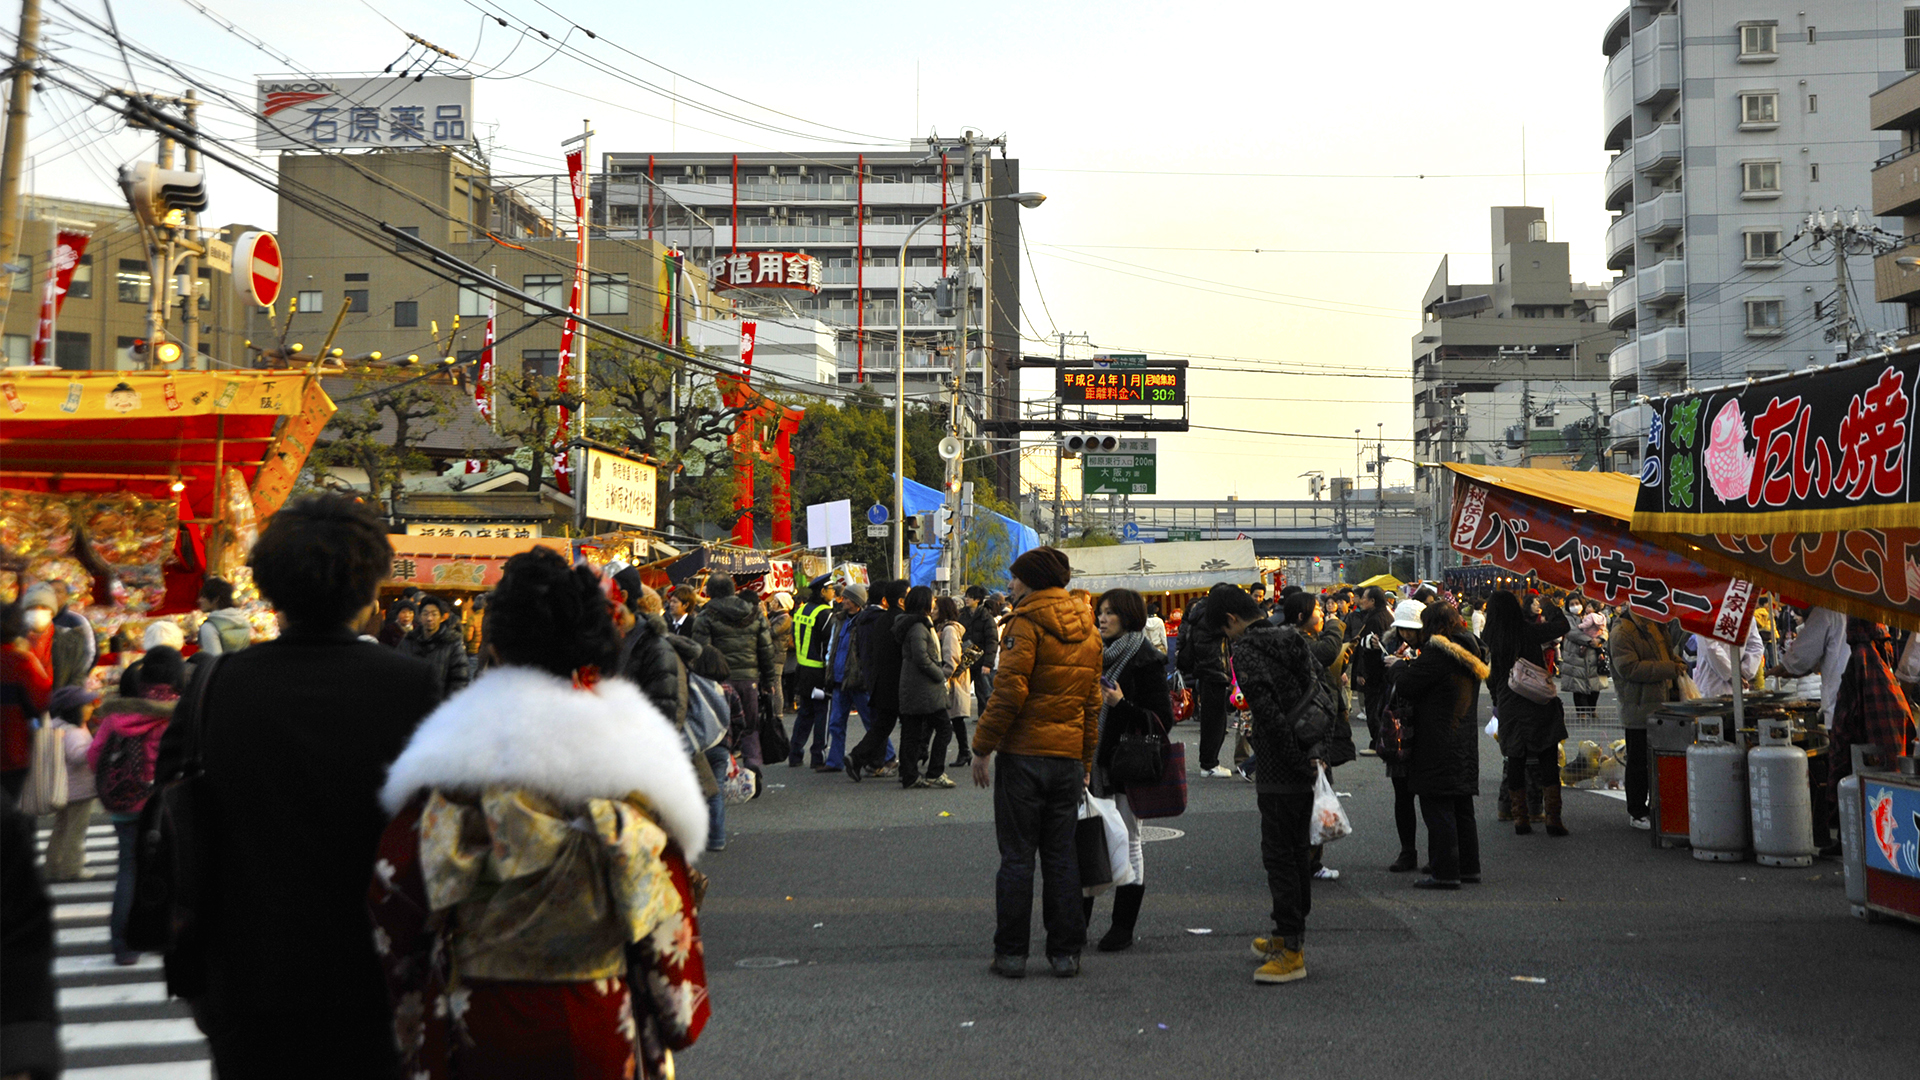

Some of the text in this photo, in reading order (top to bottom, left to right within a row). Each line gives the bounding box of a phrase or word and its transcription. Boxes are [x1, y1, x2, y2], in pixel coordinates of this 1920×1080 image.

[261, 83, 334, 94] UNICON
[306, 105, 465, 143] 石原薬品
[1064, 374, 1141, 387] 平成24年1月
[1085, 387, 1141, 400] 距離料金へ
[1152, 389, 1176, 401] 30分
[1669, 397, 1702, 509] 特製
[1747, 365, 1910, 509] たい焼
[1135, 457, 1154, 466] 200m
[1457, 485, 1486, 546] 秘伝のタレ
[1475, 511, 1713, 615] バーベキュー
[1713, 578, 1750, 639] 自家製
